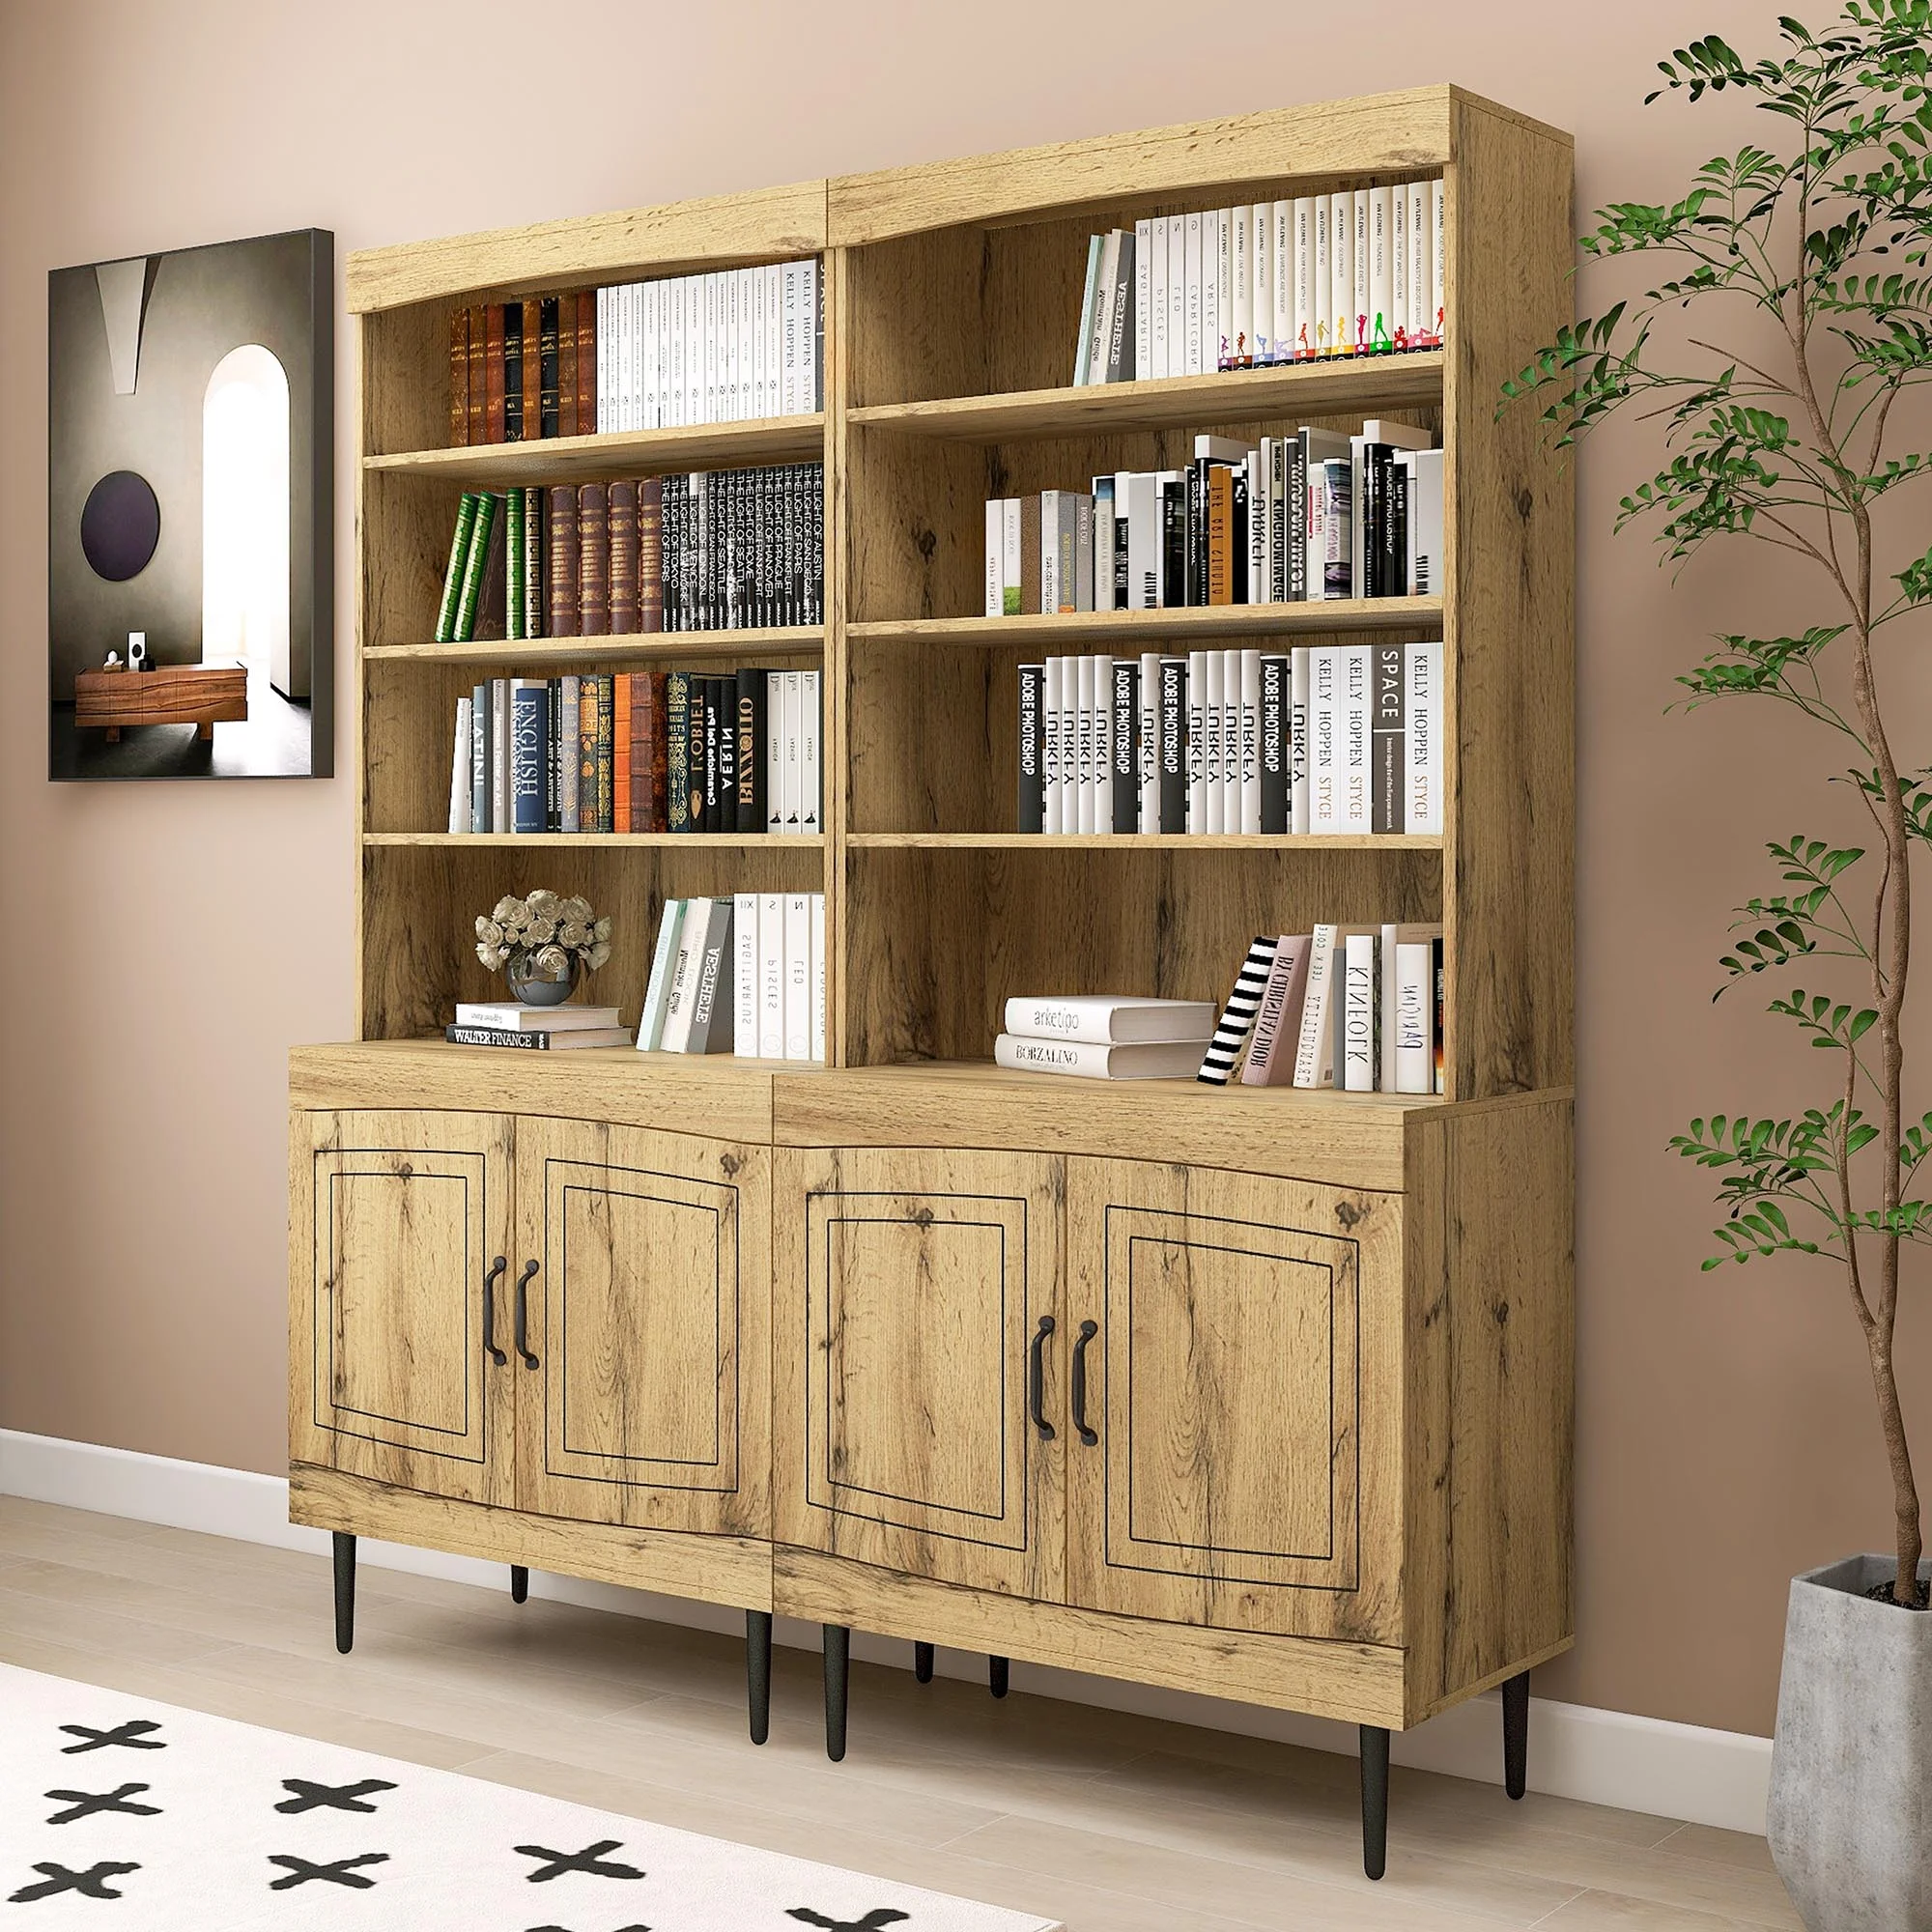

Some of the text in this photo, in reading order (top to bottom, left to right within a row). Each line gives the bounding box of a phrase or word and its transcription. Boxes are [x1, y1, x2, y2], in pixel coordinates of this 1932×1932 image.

[786, 272, 795, 310] KELLY
[803, 270, 811, 307] KELLY
[786, 320, 795, 368] HOPPEN
[803, 317, 811, 366] HOPPEN
[661, 481, 669, 582] THE LIGHT OF PARIS
[670, 481, 679, 588] THE LIGHT OF TOKYO
[718, 531, 725, 546] OF
[736, 530, 744, 545] OF
[746, 474, 754, 579] THE LIGHT OF ROME
[765, 528, 773, 542] OF
[775, 527, 782, 542] OF
[794, 526, 802, 541] OF
[814, 525, 822, 539] OF
[698, 550, 707, 595] LONDON
[1319, 658, 1331, 701] KELLY
[1350, 657, 1362, 700] KELLY
[1381, 651, 1399, 718] SPACE
[1414, 655, 1428, 698] KELLY
[1021, 673, 1035, 776] ADOBE PHOTOSHOP
[1116, 669, 1130, 774] ADOBE PHOTOSHOP
[1164, 668, 1178, 774] ADOBE PHOTOSHOP
[1264, 665, 1279, 772] ADOBE PHOTOSHOP
[1319, 711, 1331, 767] HOPPEN
[1350, 710, 1362, 766] HOPPEN
[1414, 708, 1428, 765] HOPPEN
[521, 699, 538, 796] ENGLISH
[495, 780, 502, 791] on
[454, 1029, 531, 1047] WALTER FINANCE
[1035, 1007, 1079, 1034] arketipo
[1016, 1044, 1078, 1065] BORZALINO
